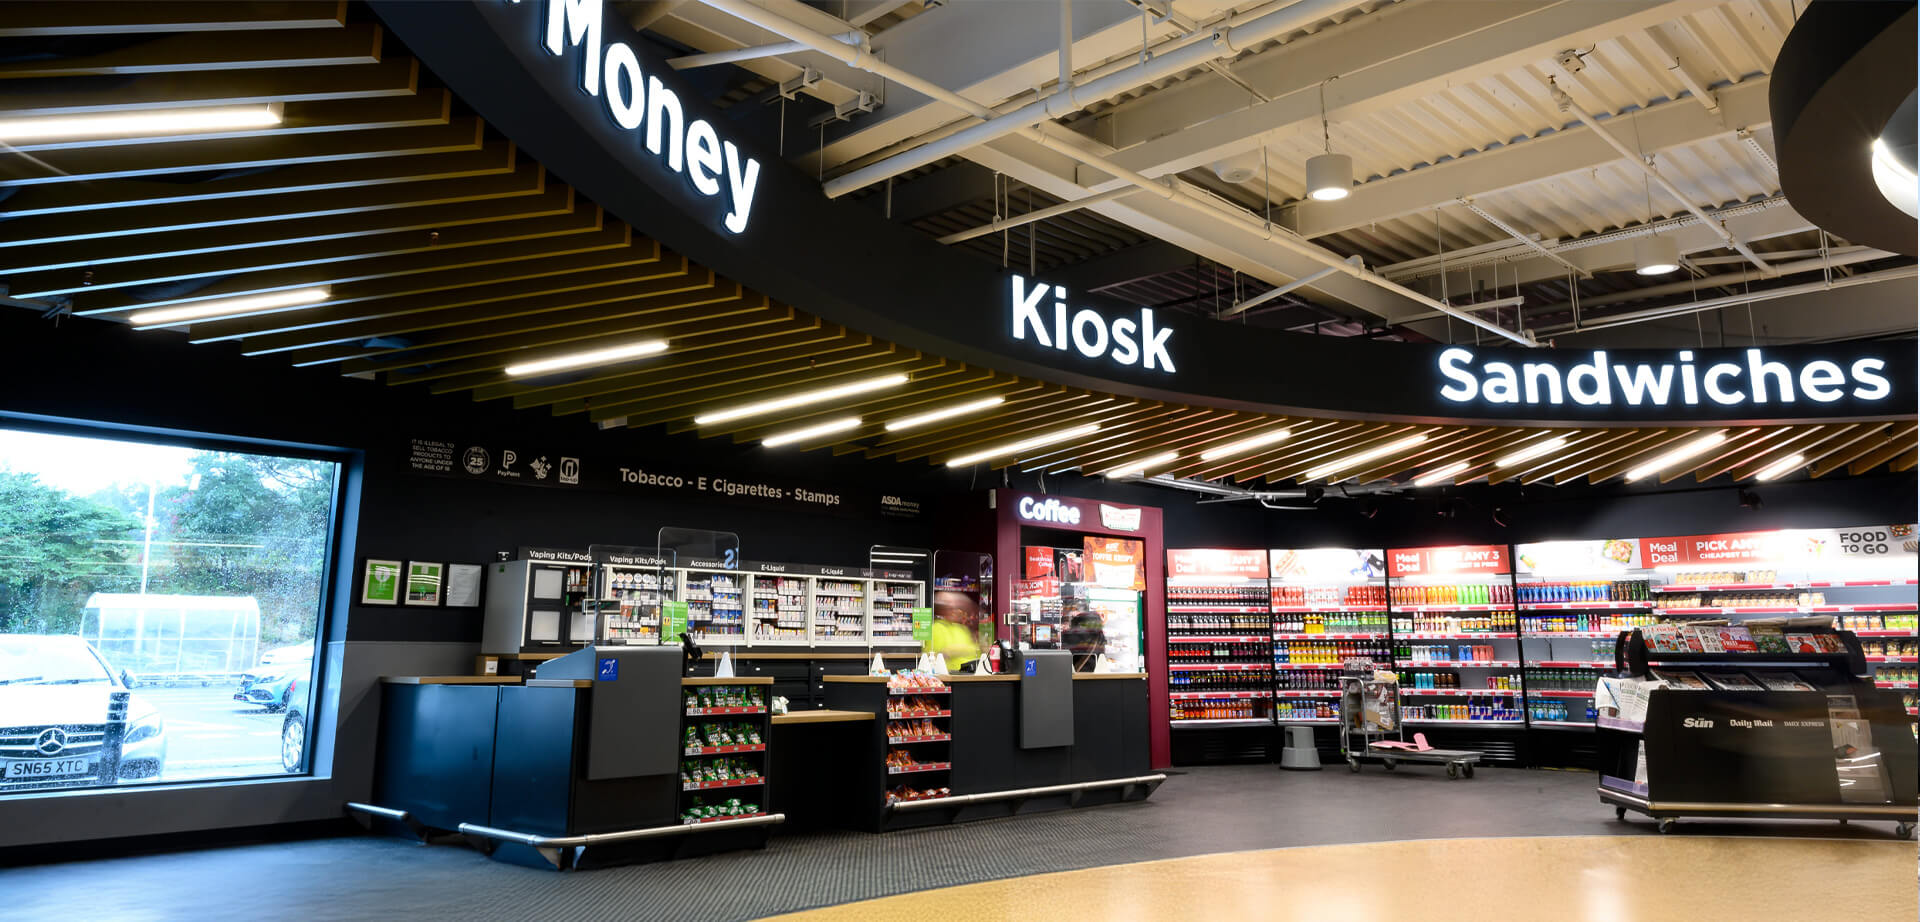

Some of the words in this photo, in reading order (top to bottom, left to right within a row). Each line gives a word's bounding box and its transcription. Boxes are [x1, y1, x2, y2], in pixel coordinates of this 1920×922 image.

[546, 0, 760, 233] Money
[1011, 274, 1176, 373] Kiosk
[1438, 348, 1891, 405] Sandwiches
[470, 457, 484, 466] 25
[619, 467, 684, 488] Tobacco
[697, 477, 707, 490] E
[712, 478, 782, 499] Cigarettes
[794, 487, 840, 507] Stamps
[881, 496, 902, 506] ASDA
[1019, 496, 1081, 525] Coffee
[1840, 532, 1887, 543] FOOD
[1649, 541, 1678, 552] Meal
[1696, 540, 1728, 551] PICK
[1841, 545, 1860, 553] TO
[1863, 543, 1889, 554] GO
[529, 550, 556, 560] Vaping
[556, 552, 593, 561] Kits/Pods
[609, 555, 633, 564] Vaping
[634, 556, 667, 565] Kits/Pods
[1493, 551, 1500, 560] 3
[1651, 552, 1678, 563] Deal
[1699, 551, 1741, 559] CHEAPEST
[690, 560, 726, 568] Accessories
[760, 564, 785, 572] E-Liquid
[1397, 562, 1420, 572] Deal
[1729, 719, 1753, 728] Daily
[1754, 719, 1774, 727] Mail
[13, 762, 52, 775] SN65
[56, 760, 83, 773] XTC
